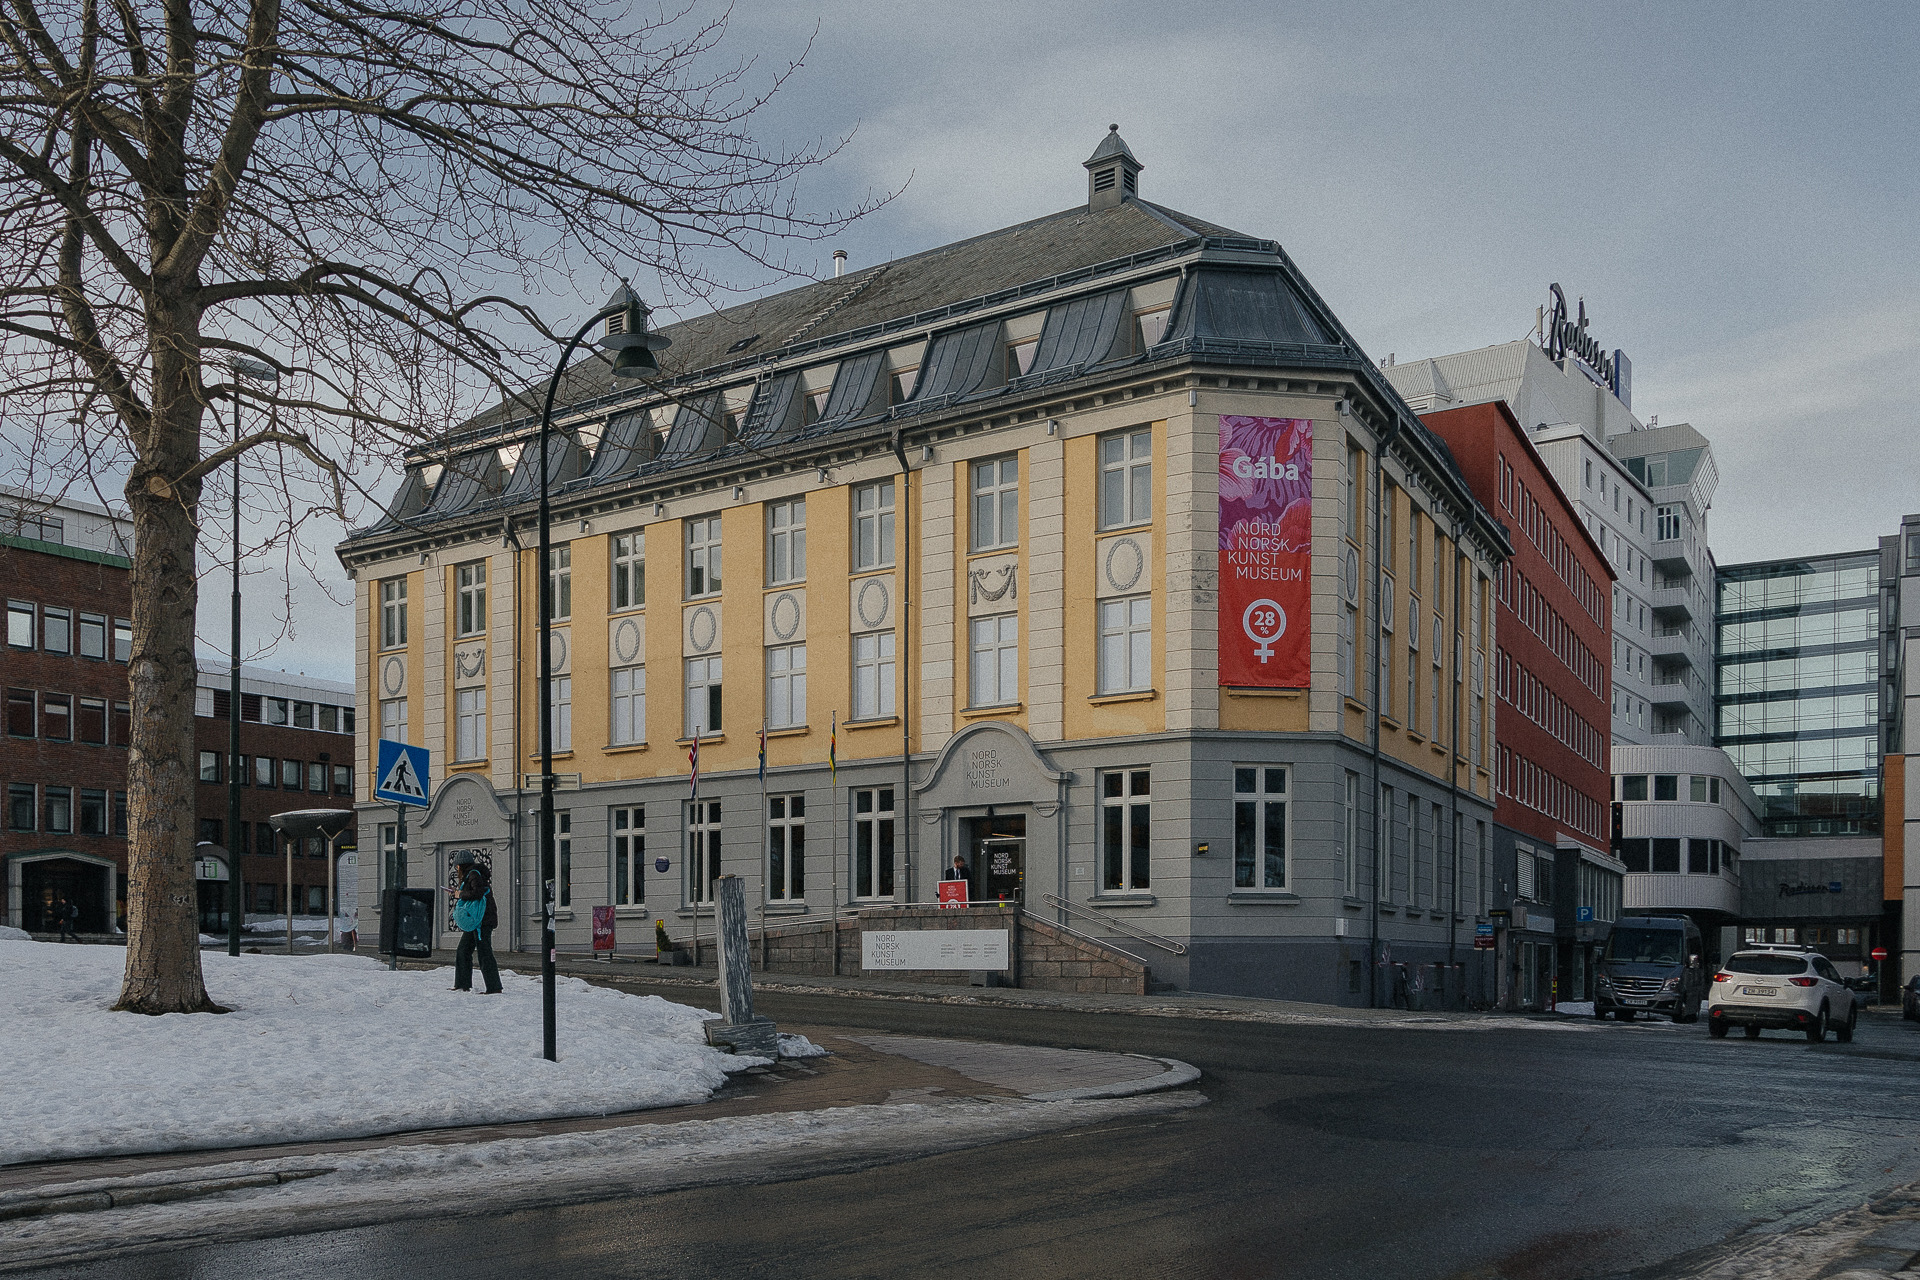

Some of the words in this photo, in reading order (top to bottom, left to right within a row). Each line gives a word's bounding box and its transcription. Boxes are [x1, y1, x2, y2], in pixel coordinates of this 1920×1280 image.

[1232, 455, 1299, 481] Gába
[1238, 521, 1281, 536] NORD
[1238, 536, 1290, 551] NORSK
[1228, 551, 1280, 566] KUNST
[1236, 566, 1302, 582] MUSEUM
[1254, 610, 1275, 627] 28
[1260, 626, 1270, 635] %
[972, 749, 997, 760] NORD
[972, 759, 1002, 770] NORSK
[966, 769, 996, 780] KUNST
[970, 778, 1010, 789] MUSEUM
[456, 798, 472, 806] NORD
[452, 812, 471, 820] KUNST
[455, 819, 479, 827] MUSEUM
[1580, 908, 1589, 920] P
[875, 934, 896, 943] NORD
[875, 942, 900, 951] NORSK
[871, 950, 895, 959] KUNST
[874, 958, 906, 967] MUSEUM
